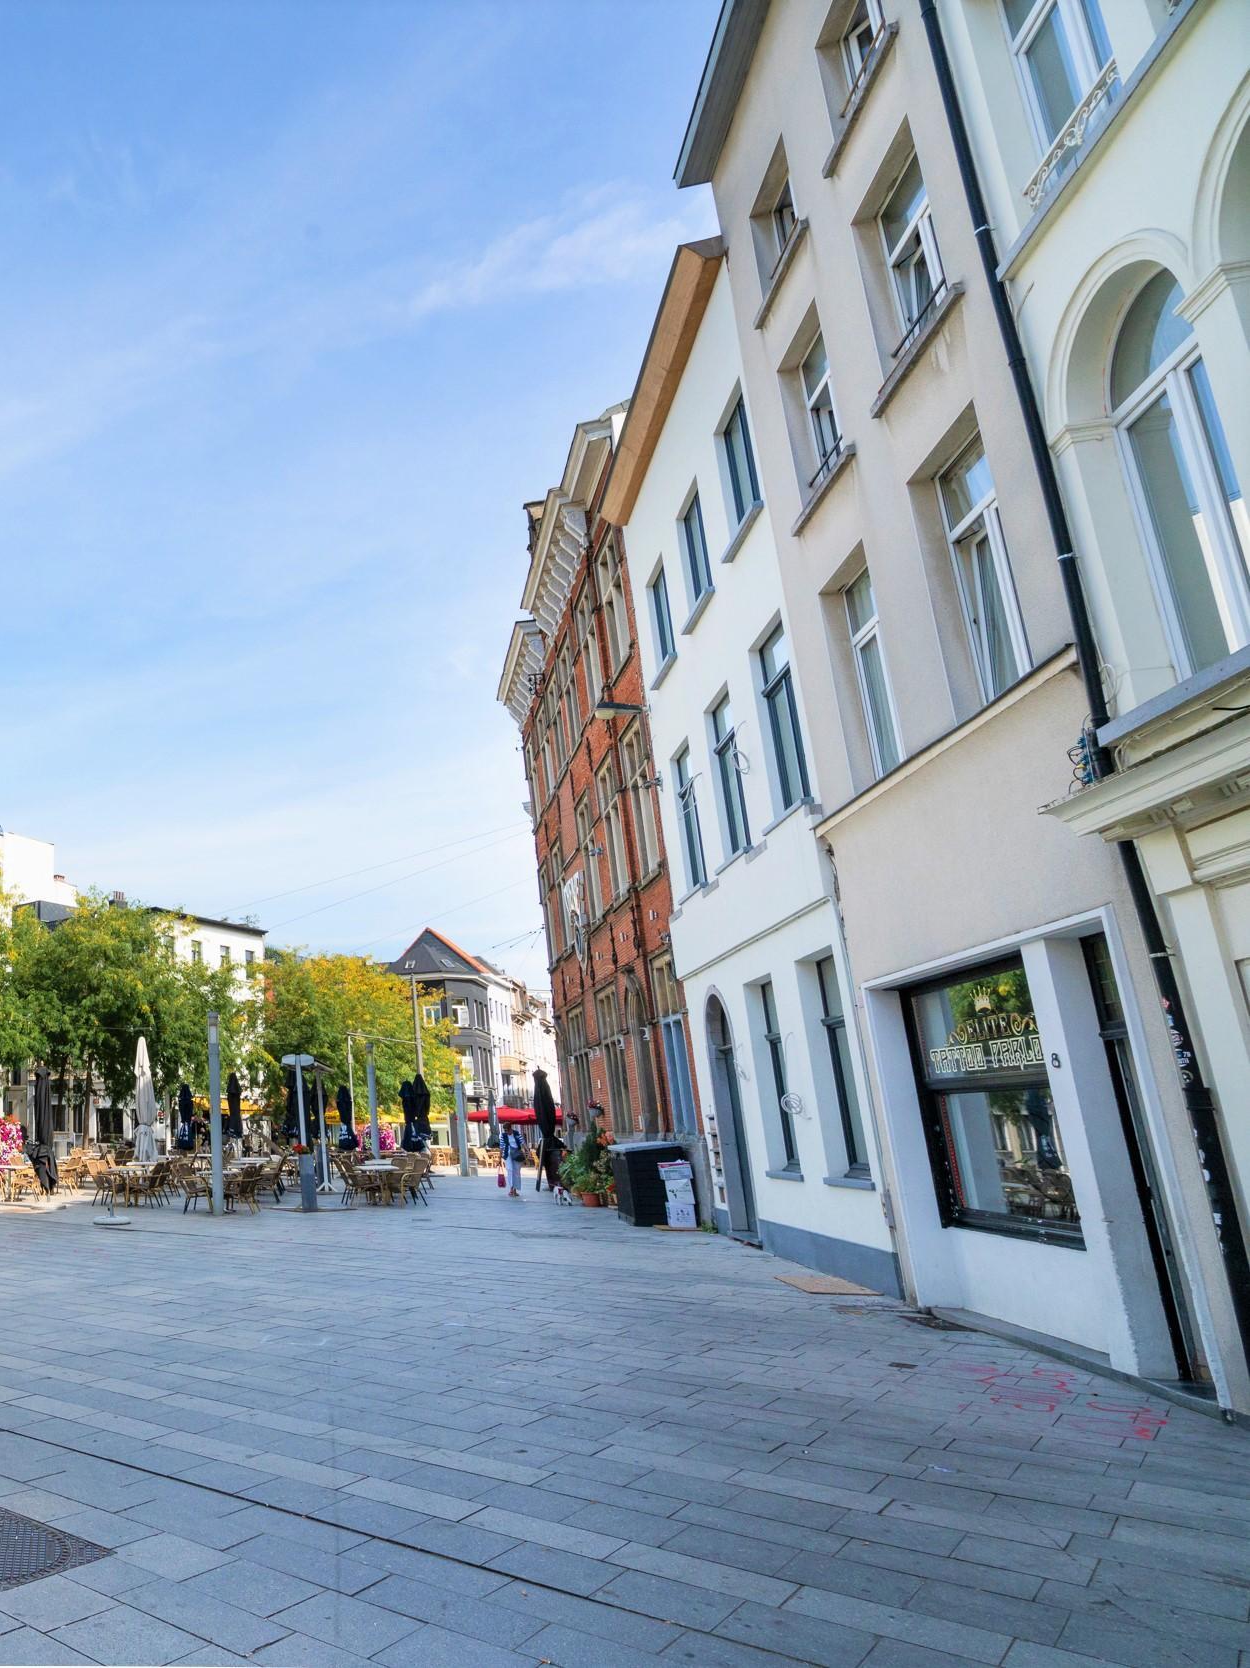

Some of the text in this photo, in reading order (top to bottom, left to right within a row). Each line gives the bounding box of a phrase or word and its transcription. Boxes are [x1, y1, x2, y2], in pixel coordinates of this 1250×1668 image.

[966, 1014, 1010, 1041] ELITE
[930, 1043, 987, 1074] TATTOO
[1051, 1052, 1061, 1069] 8
